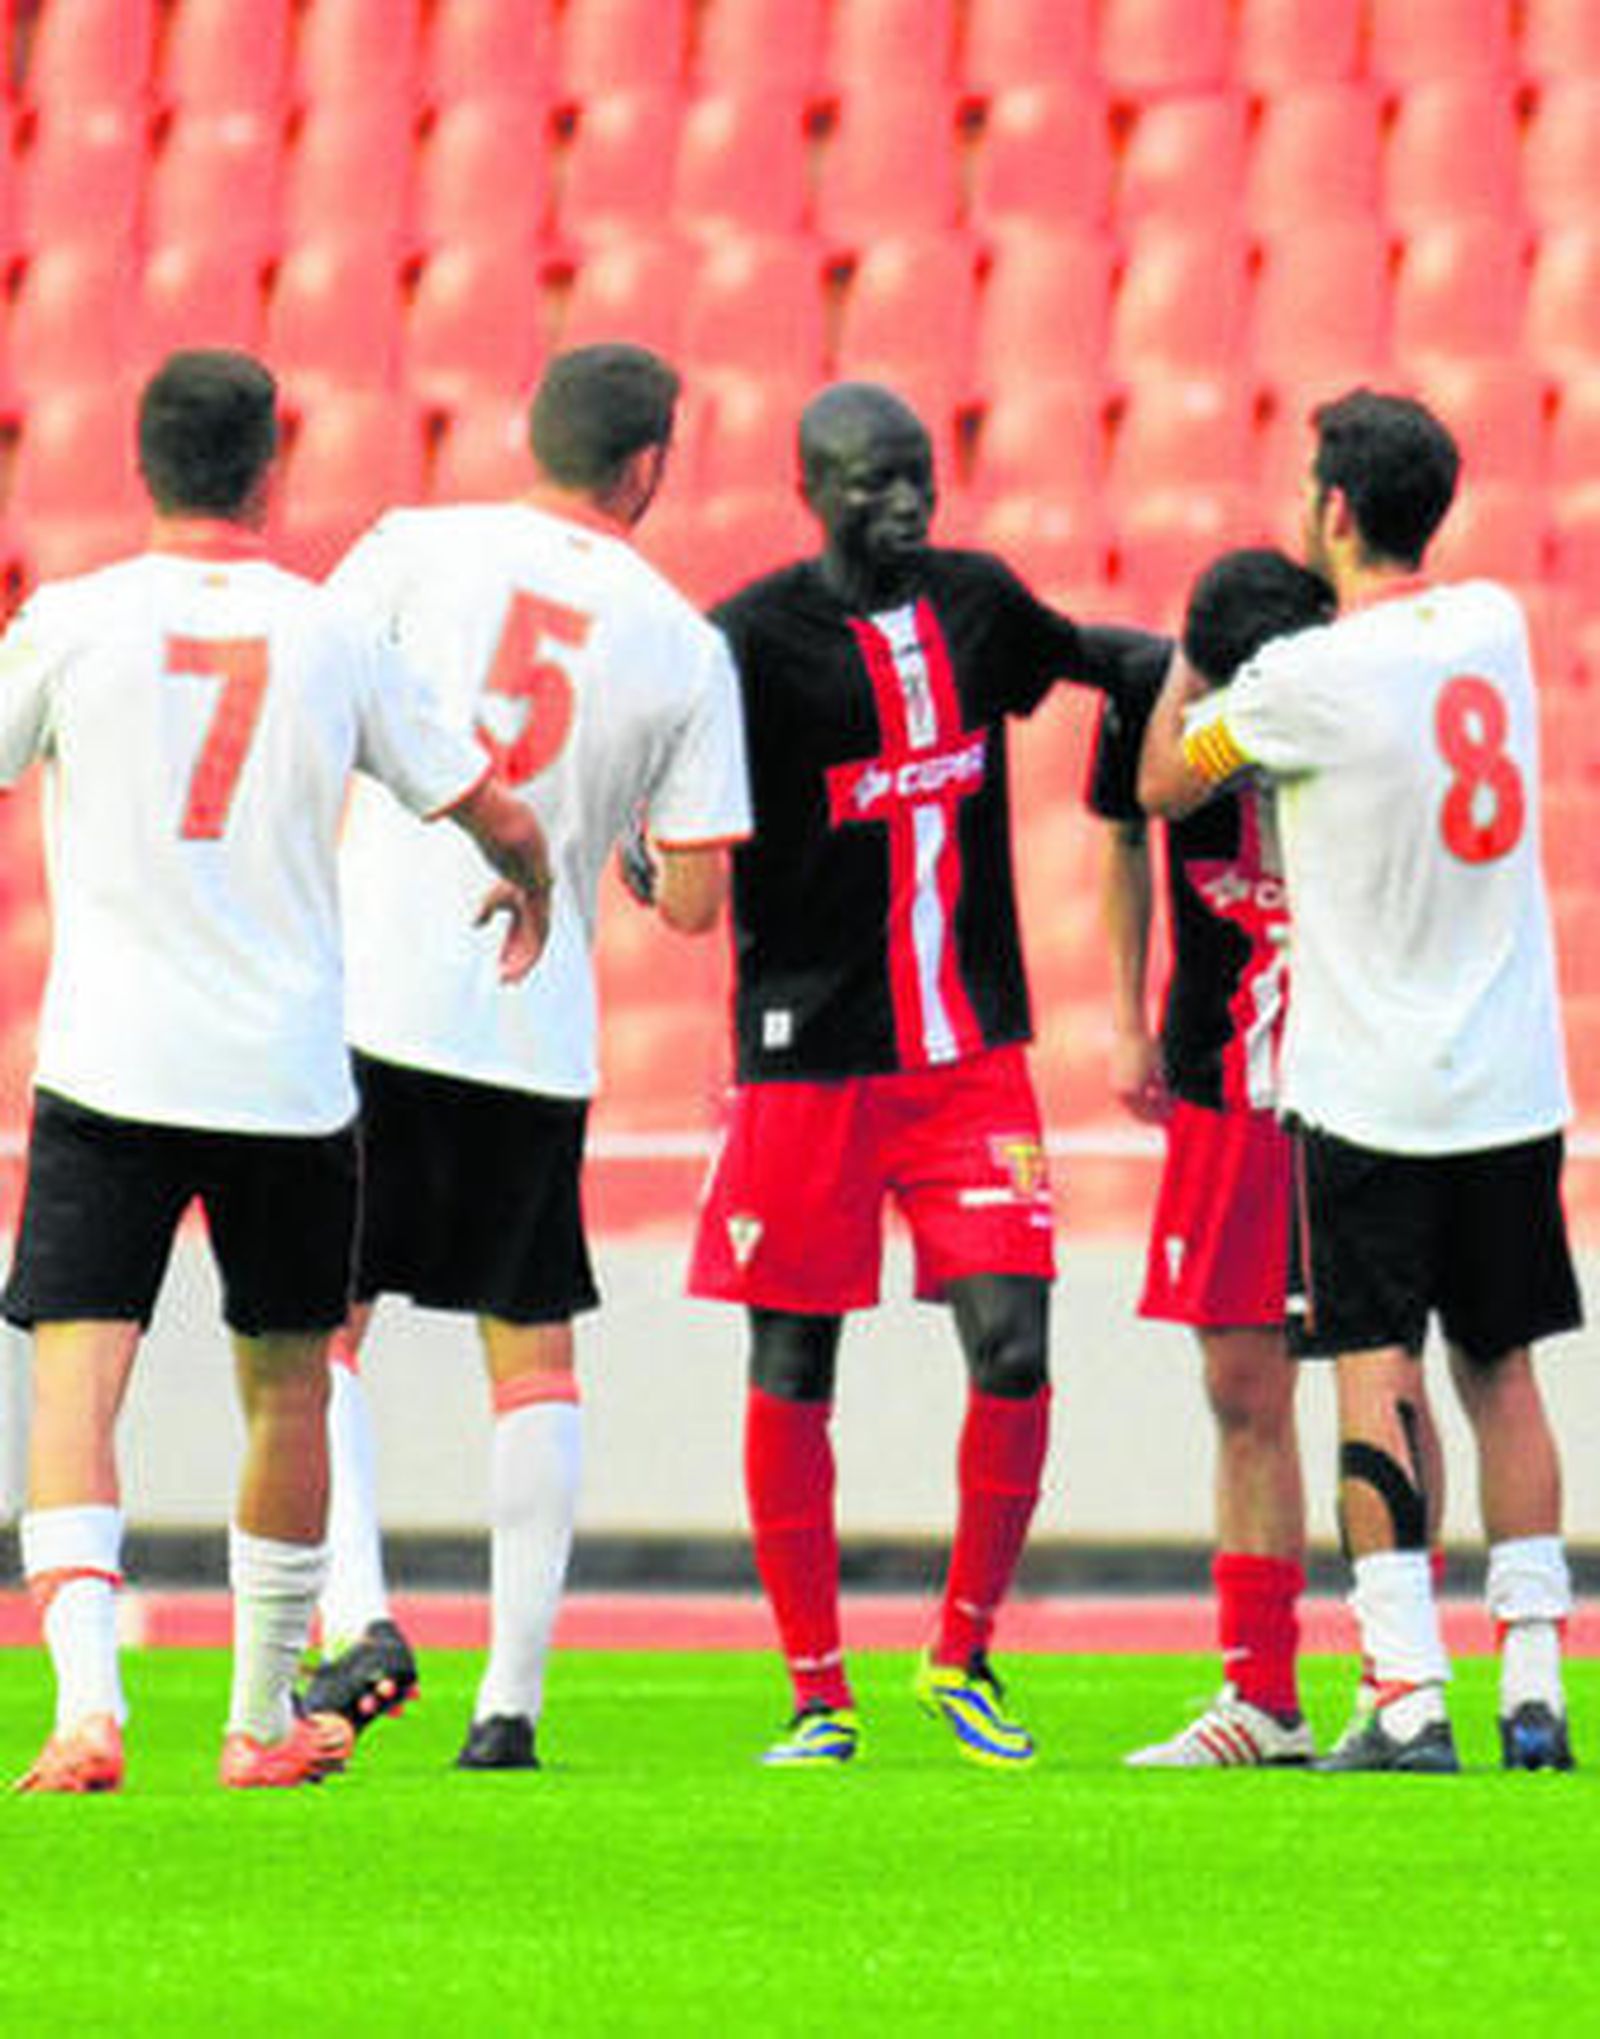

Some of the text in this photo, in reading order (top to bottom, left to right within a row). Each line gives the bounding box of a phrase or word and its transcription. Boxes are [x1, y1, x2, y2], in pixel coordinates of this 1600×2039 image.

[163, 635, 269, 840] 7
[479, 588, 595, 787] 5
[1434, 674, 1526, 866] 8
